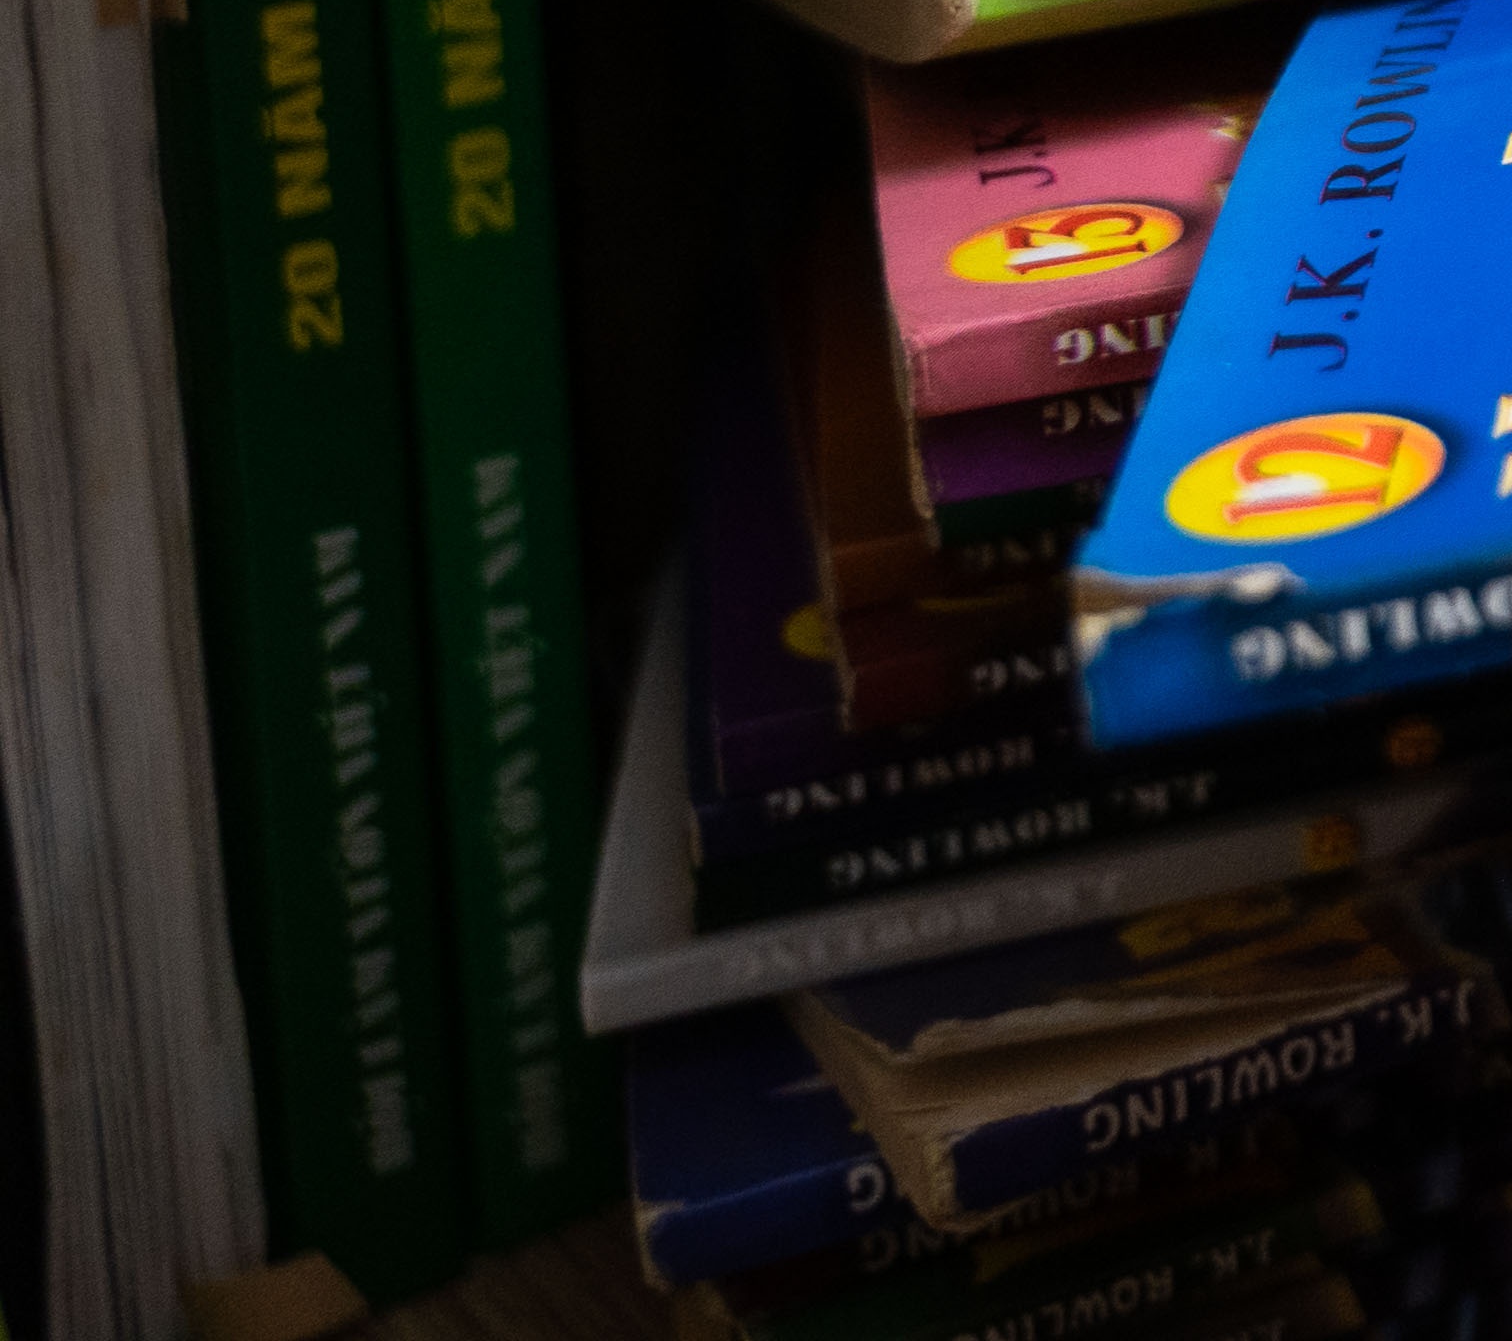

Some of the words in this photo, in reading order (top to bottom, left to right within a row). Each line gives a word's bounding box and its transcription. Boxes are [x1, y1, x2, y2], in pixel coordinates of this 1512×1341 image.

[445, 125, 518, 241] 20
[1003, 210, 1147, 274] 13
[280, 237, 344, 355] 20
[1269, 228, 1383, 371] J.K.
[1222, 420, 1405, 528] 12
[766, 731, 1036, 821] ROWLING
[829, 800, 1092, 887] ROWLING
[1375, 978, 1476, 1046] J.K.
[1082, 1020, 1356, 1149] ROWLING
[1176, 1224, 1274, 1281] J.K.
